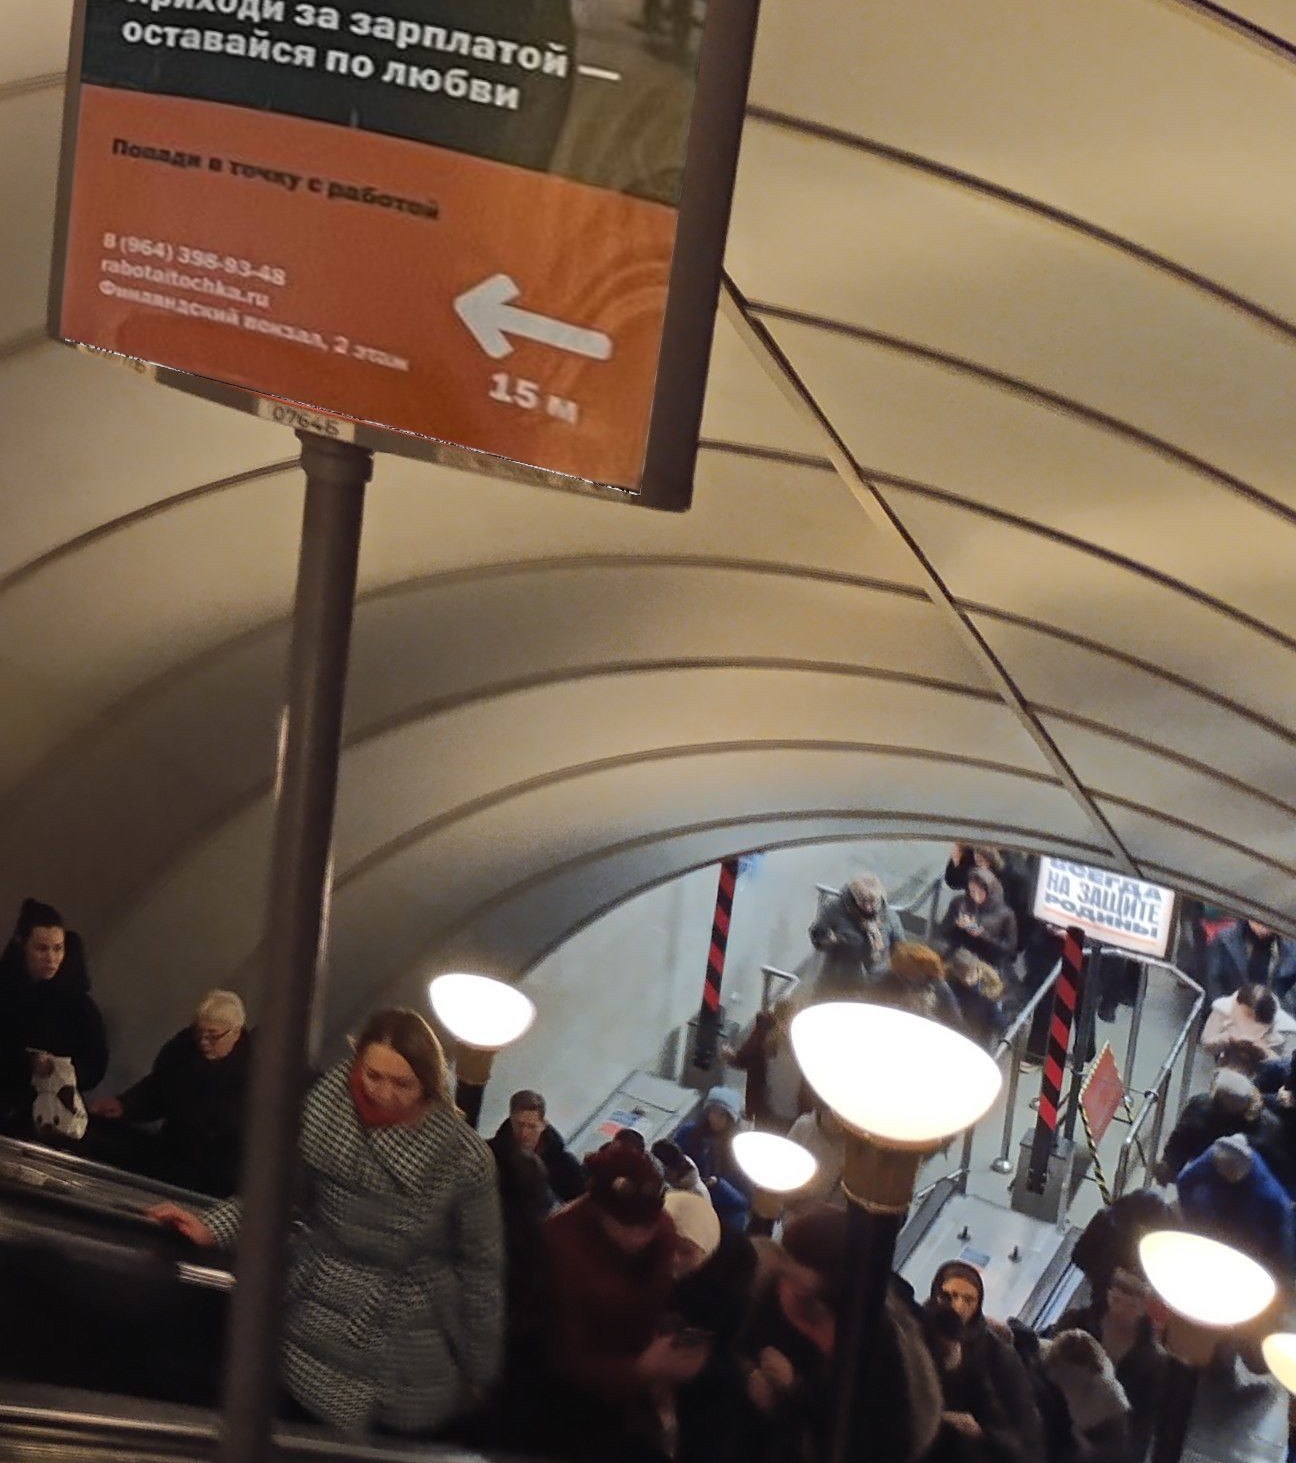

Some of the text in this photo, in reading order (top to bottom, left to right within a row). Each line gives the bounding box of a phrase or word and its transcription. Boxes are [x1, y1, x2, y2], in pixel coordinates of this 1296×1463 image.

[121, 20, 521, 110] оставайся по любви
[294, 3, 340, 30] за
[349, 11, 569, 78] зарплатой
[112, 137, 440, 221] Попади в точку с работой
[103, 232, 117, 250] 8
[119, 236, 174, 263] (964)
[332, 335, 350, 356] 2
[488, 372, 579, 424] 15 м
[1046, 868, 1160, 925] НА ЗАЩИТЕ
[1048, 856, 1163, 901] ВСЕГДА
[1044, 892, 1159, 939] РОДИНЫ
